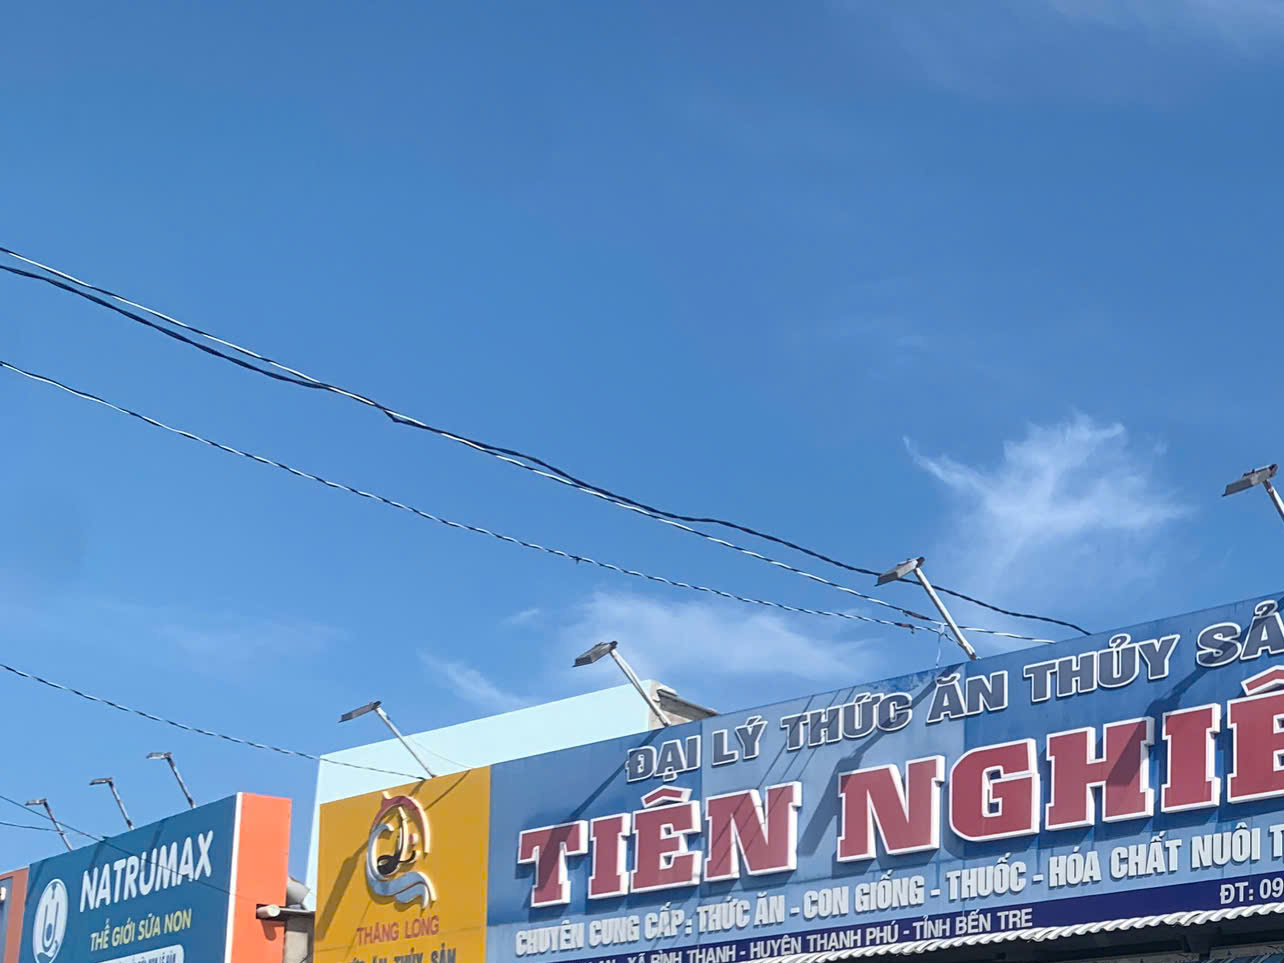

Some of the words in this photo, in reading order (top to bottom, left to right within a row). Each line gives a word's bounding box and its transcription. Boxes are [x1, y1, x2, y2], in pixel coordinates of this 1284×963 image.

[626, 737, 700, 783] ĐẠI
[712, 716, 768, 766] LÝ
[780, 691, 912, 751] THỨC
[926, 670, 1008, 725] ĂN
[1024, 633, 1180, 702] THỦY
[79, 830, 214, 913] NATRUMAX
[517, 780, 802, 908] TIÊN
[515, 920, 584, 957] CHUYÊN
[589, 915, 640, 947] CUNG
[697, 896, 750, 932] THỨC
[753, 892, 785, 926] ĂN
[803, 886, 849, 919] CON
[855, 869, 925, 913] GIỐNG
[946, 852, 1027, 901] THUỐC
[1049, 846, 1101, 888] HÓA
[1110, 828, 1183, 877] CHẤT
[1191, 823, 1260, 867] NUÔI
[1219, 880, 1253, 905] ĐT:
[164, 908, 192, 934] NON
[404, 915, 440, 939] LONG
[865, 921, 899, 945] PHÚ
[912, 915, 950, 939] TỈNH
[955, 909, 991, 934] BẾN
[997, 908, 1033, 929] TRE
